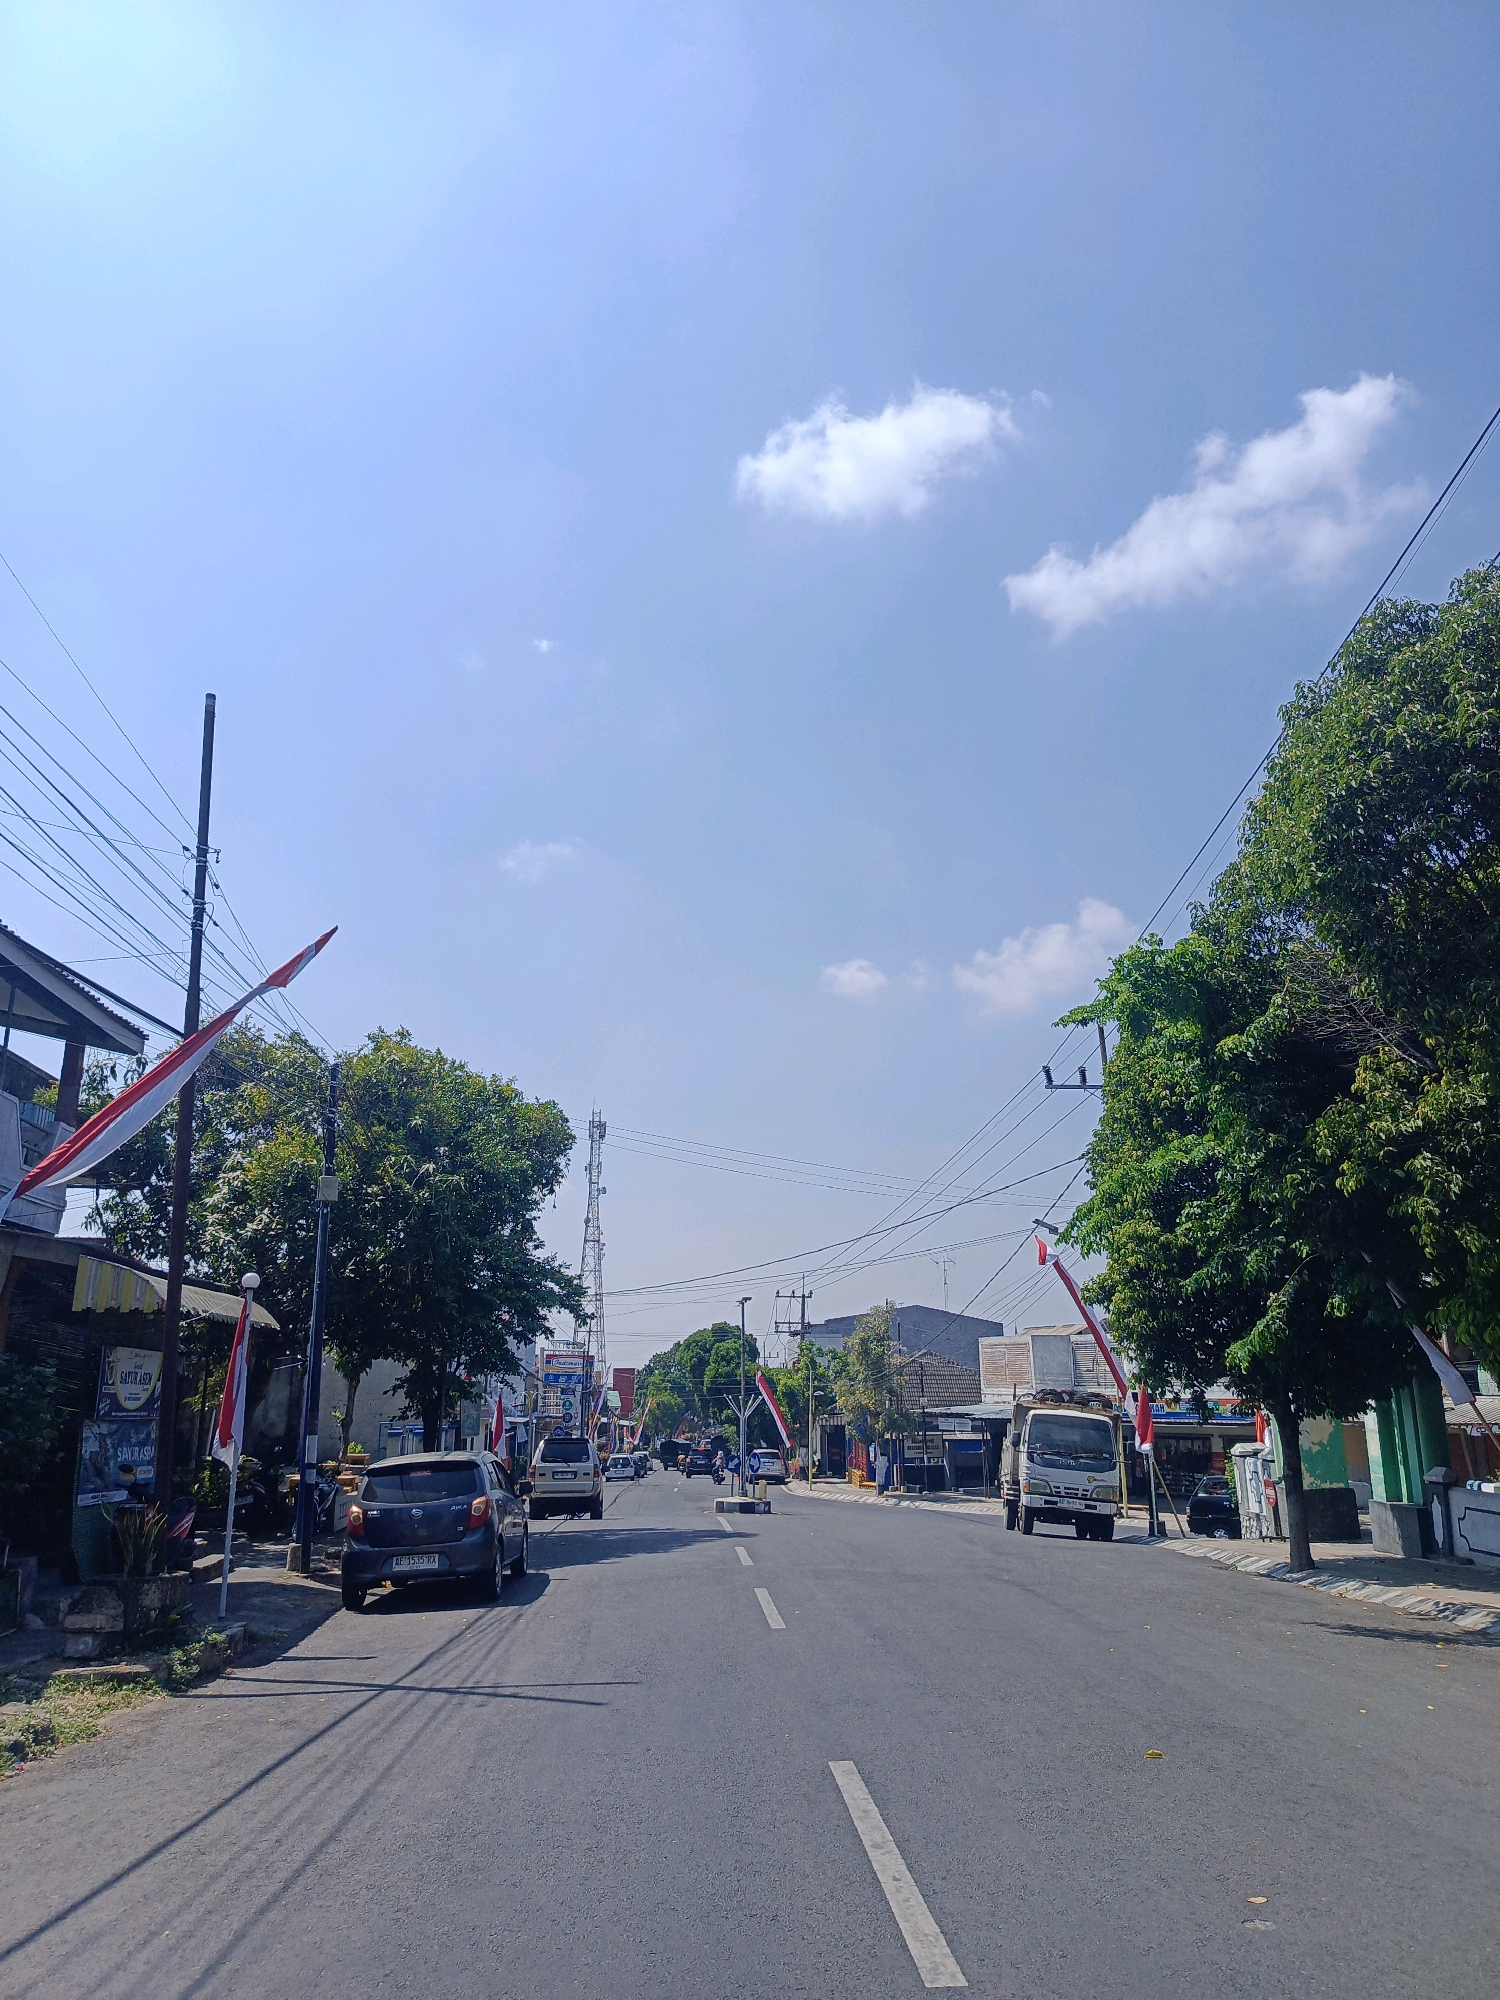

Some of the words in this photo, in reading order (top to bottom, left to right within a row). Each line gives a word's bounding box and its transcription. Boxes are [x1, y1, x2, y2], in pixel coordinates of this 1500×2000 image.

[120, 1370, 139, 1385] SAYUR
[138, 1372, 153, 1387] ASEM
[117, 1446, 139, 1461] SAYUR
[395, 1556, 403, 1566] AE
[407, 1555, 425, 1565] 1535
[427, 1554, 437, 1564] RX
